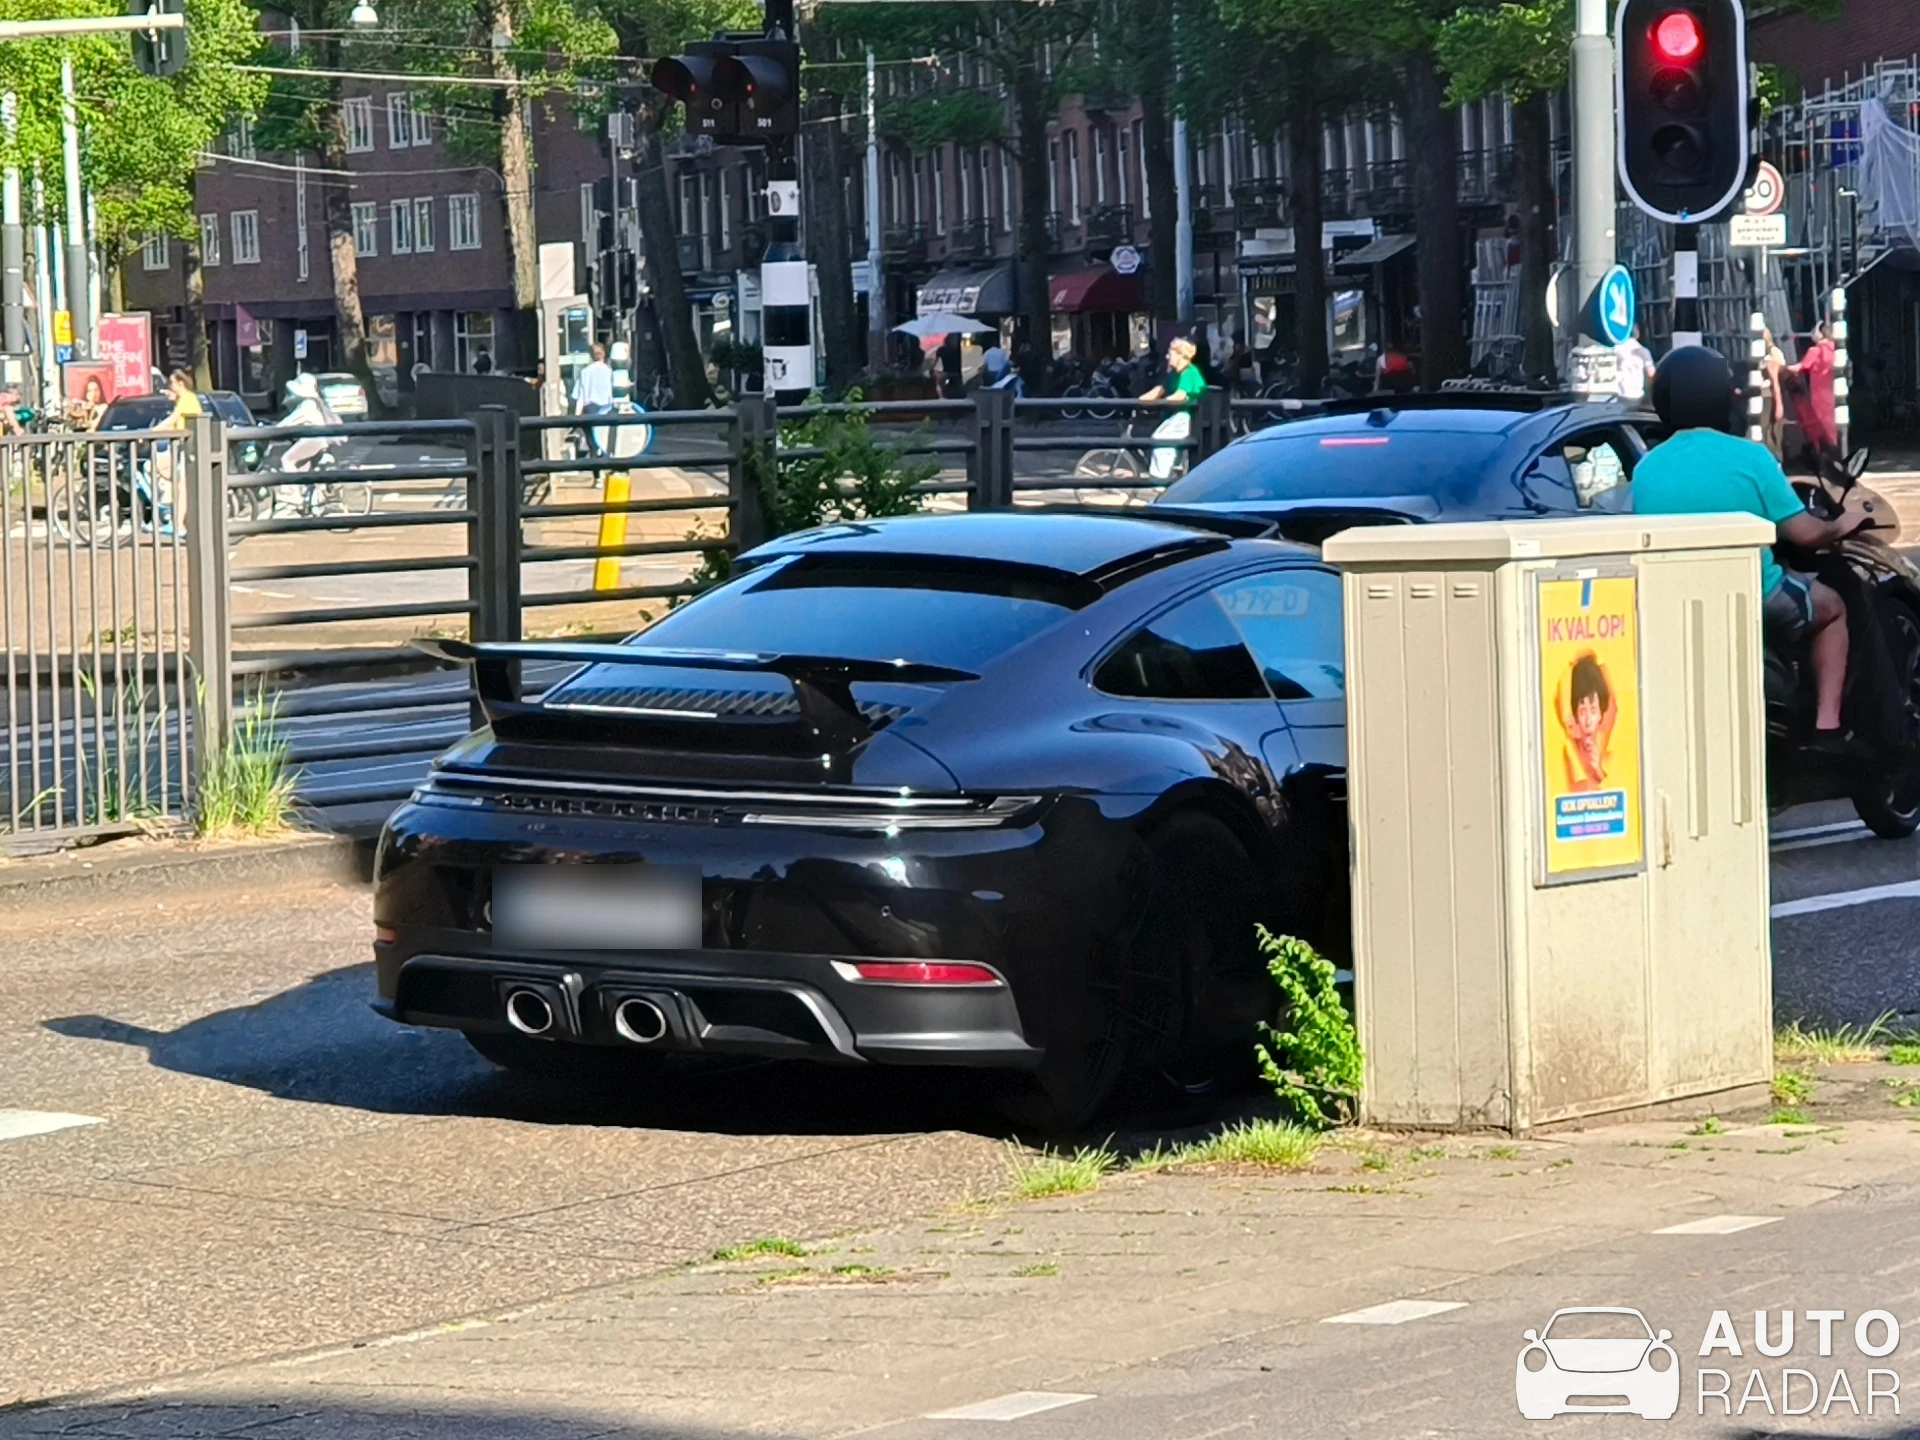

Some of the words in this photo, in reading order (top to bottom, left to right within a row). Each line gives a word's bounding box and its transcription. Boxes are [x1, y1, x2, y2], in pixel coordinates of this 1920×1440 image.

[1547, 617, 1563, 642] IK
[1565, 615, 1595, 641] VAL
[1597, 613, 1625, 639] OP!
